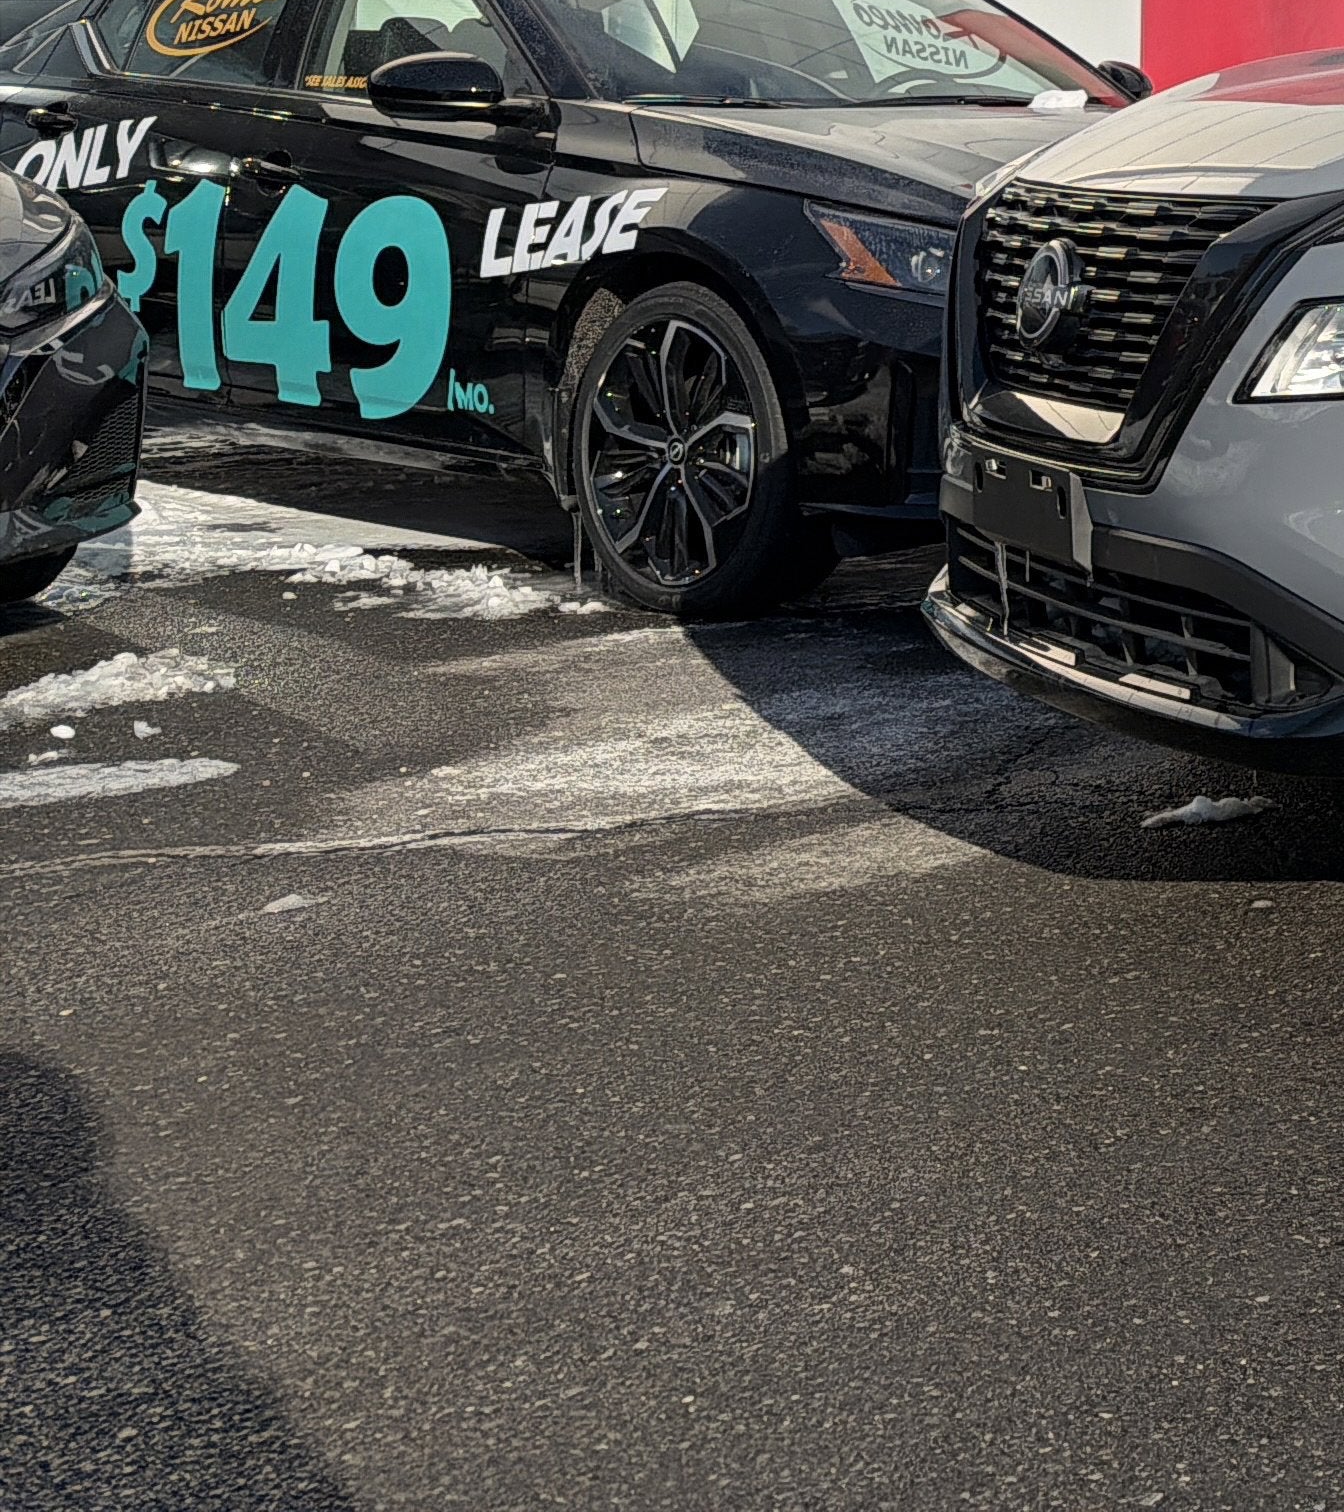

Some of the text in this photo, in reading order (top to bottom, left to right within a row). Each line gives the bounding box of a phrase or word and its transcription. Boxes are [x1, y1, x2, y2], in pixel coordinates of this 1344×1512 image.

[174, 8, 257, 45] NISSAN
[13, 115, 158, 194] ONLY
[480, 188, 669, 278] LEASE
[117, 179, 452, 419] $149
